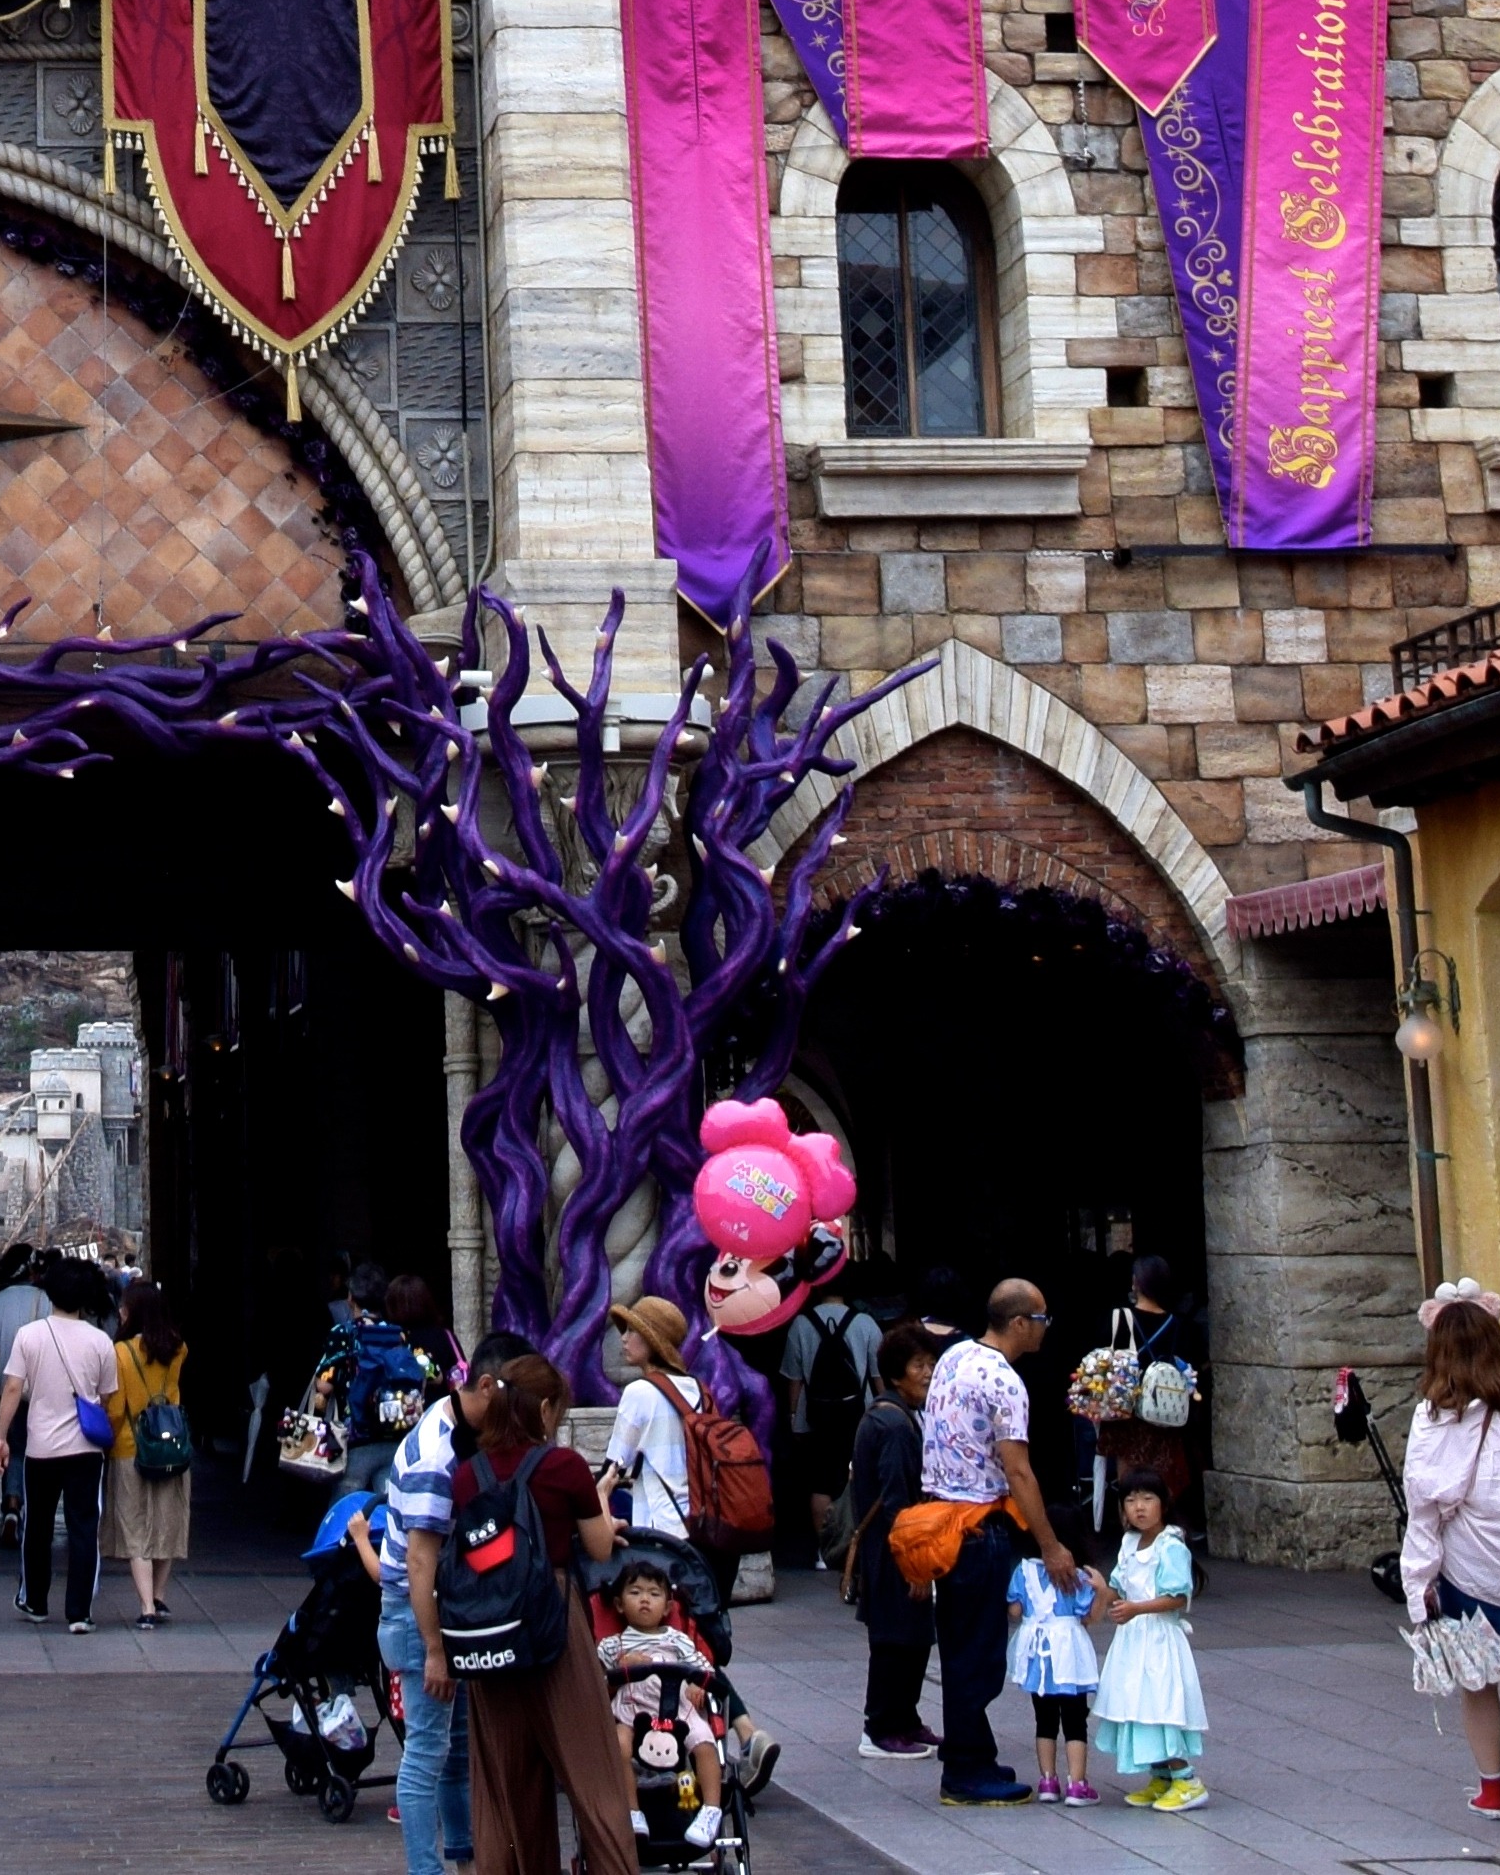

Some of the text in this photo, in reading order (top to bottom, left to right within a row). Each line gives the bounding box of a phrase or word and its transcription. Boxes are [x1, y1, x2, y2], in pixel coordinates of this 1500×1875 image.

[725, 1173, 788, 1220] MOUSE
[733, 1160, 797, 1207] MINNIE
[453, 1648, 516, 1670] adidas
